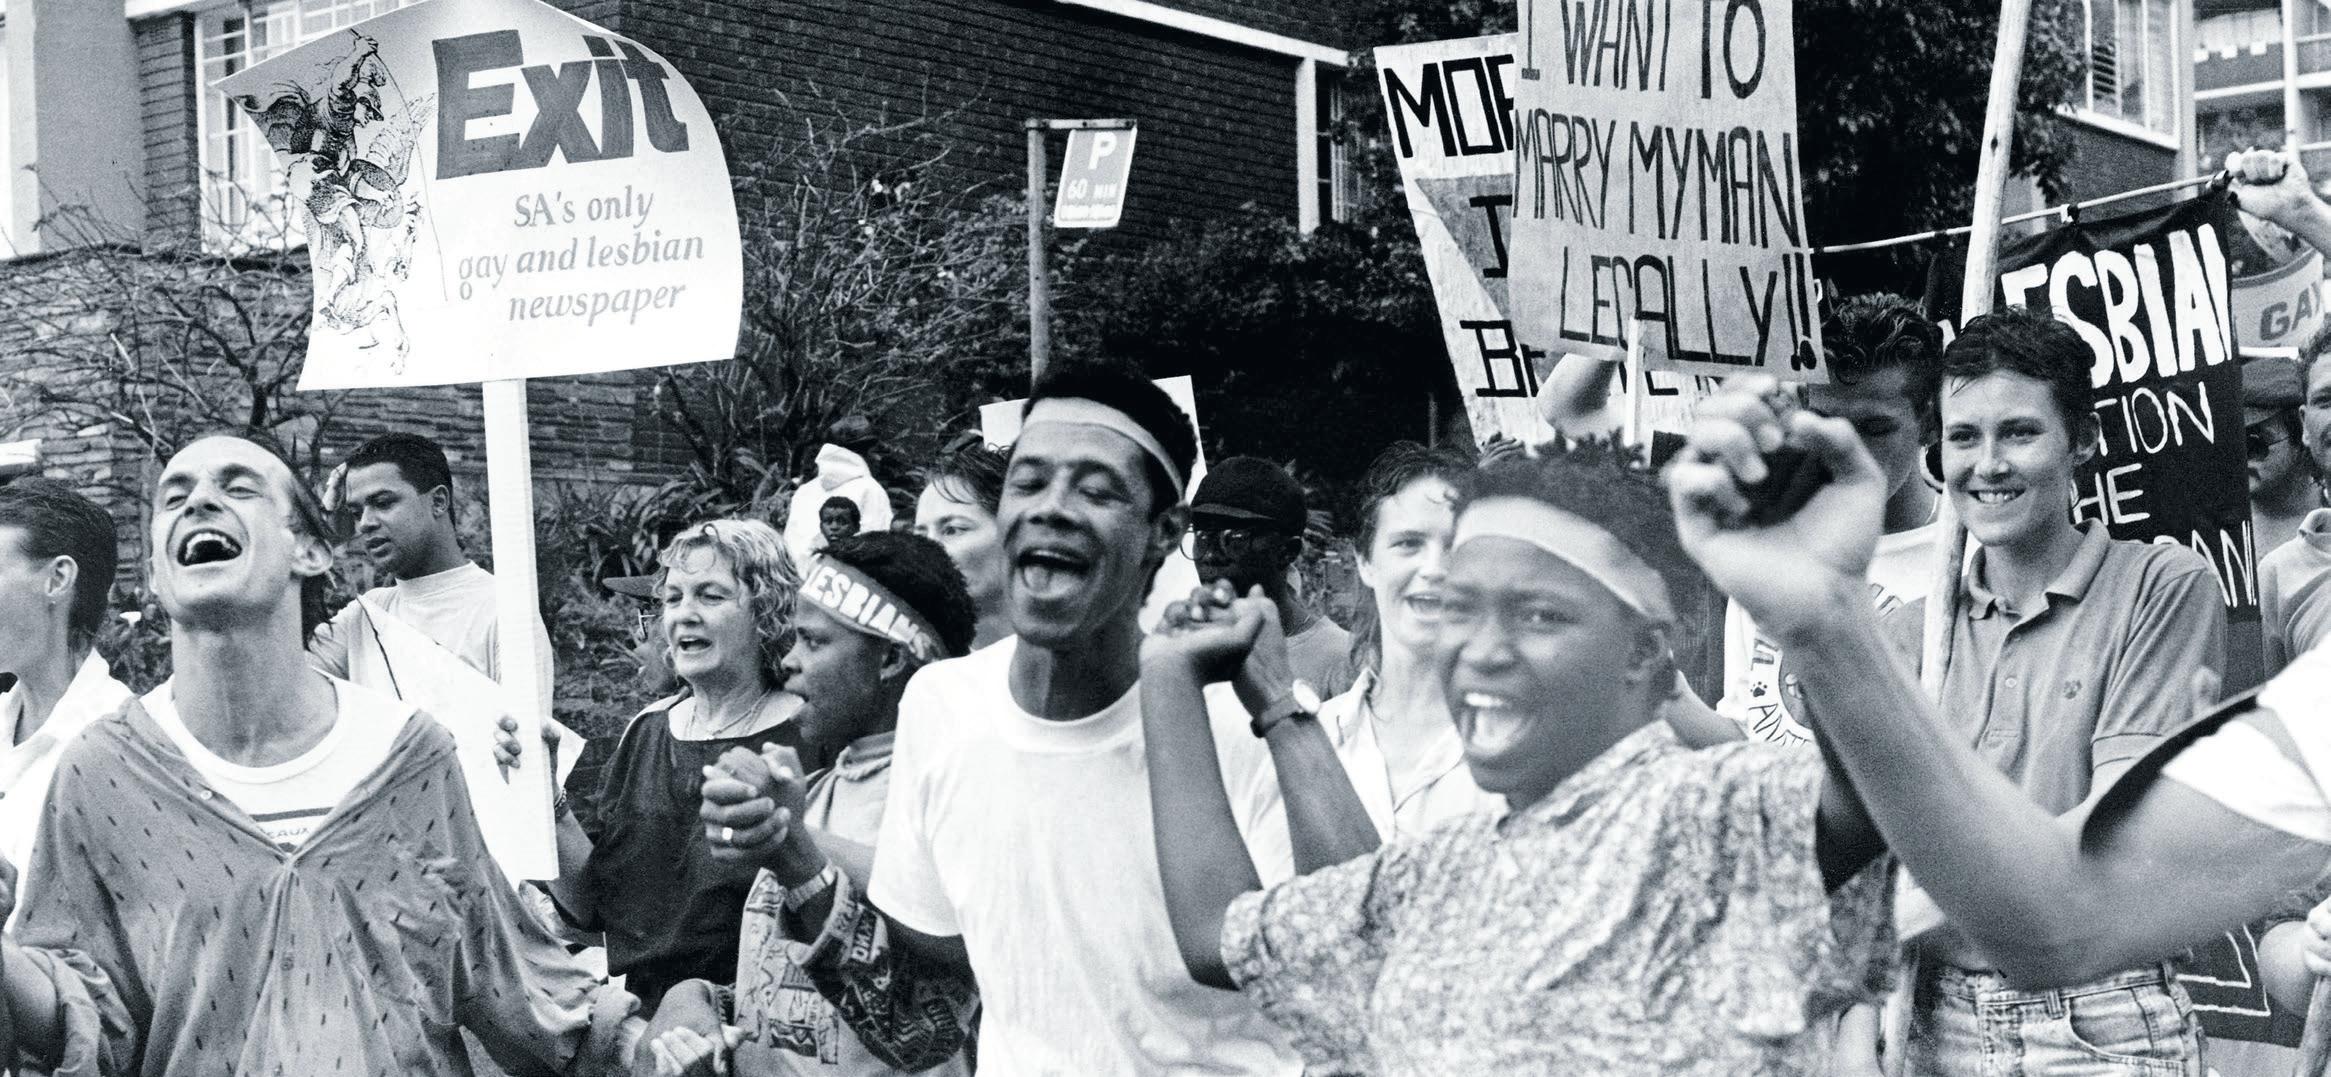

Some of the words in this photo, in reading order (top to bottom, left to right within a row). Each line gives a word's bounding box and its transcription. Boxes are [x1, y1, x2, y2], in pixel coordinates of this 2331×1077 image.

[1521, 0, 1541, 81] I
[1561, 0, 1672, 92] WANT
[1700, 0, 1766, 99] TO
[431, 29, 690, 181] Exit
[1088, 131, 1118, 170] P
[1512, 108, 1617, 230] MARRY
[1628, 121, 1693, 240] MY
[1696, 126, 1801, 249] MAN
[513, 191, 576, 228] SA's
[587, 184, 654, 229] only
[1067, 178, 1089, 200] 60
[458, 253, 508, 301] gay
[516, 237, 579, 274] and
[586, 229, 705, 270] lesbian
[508, 283, 687, 328] newspaper
